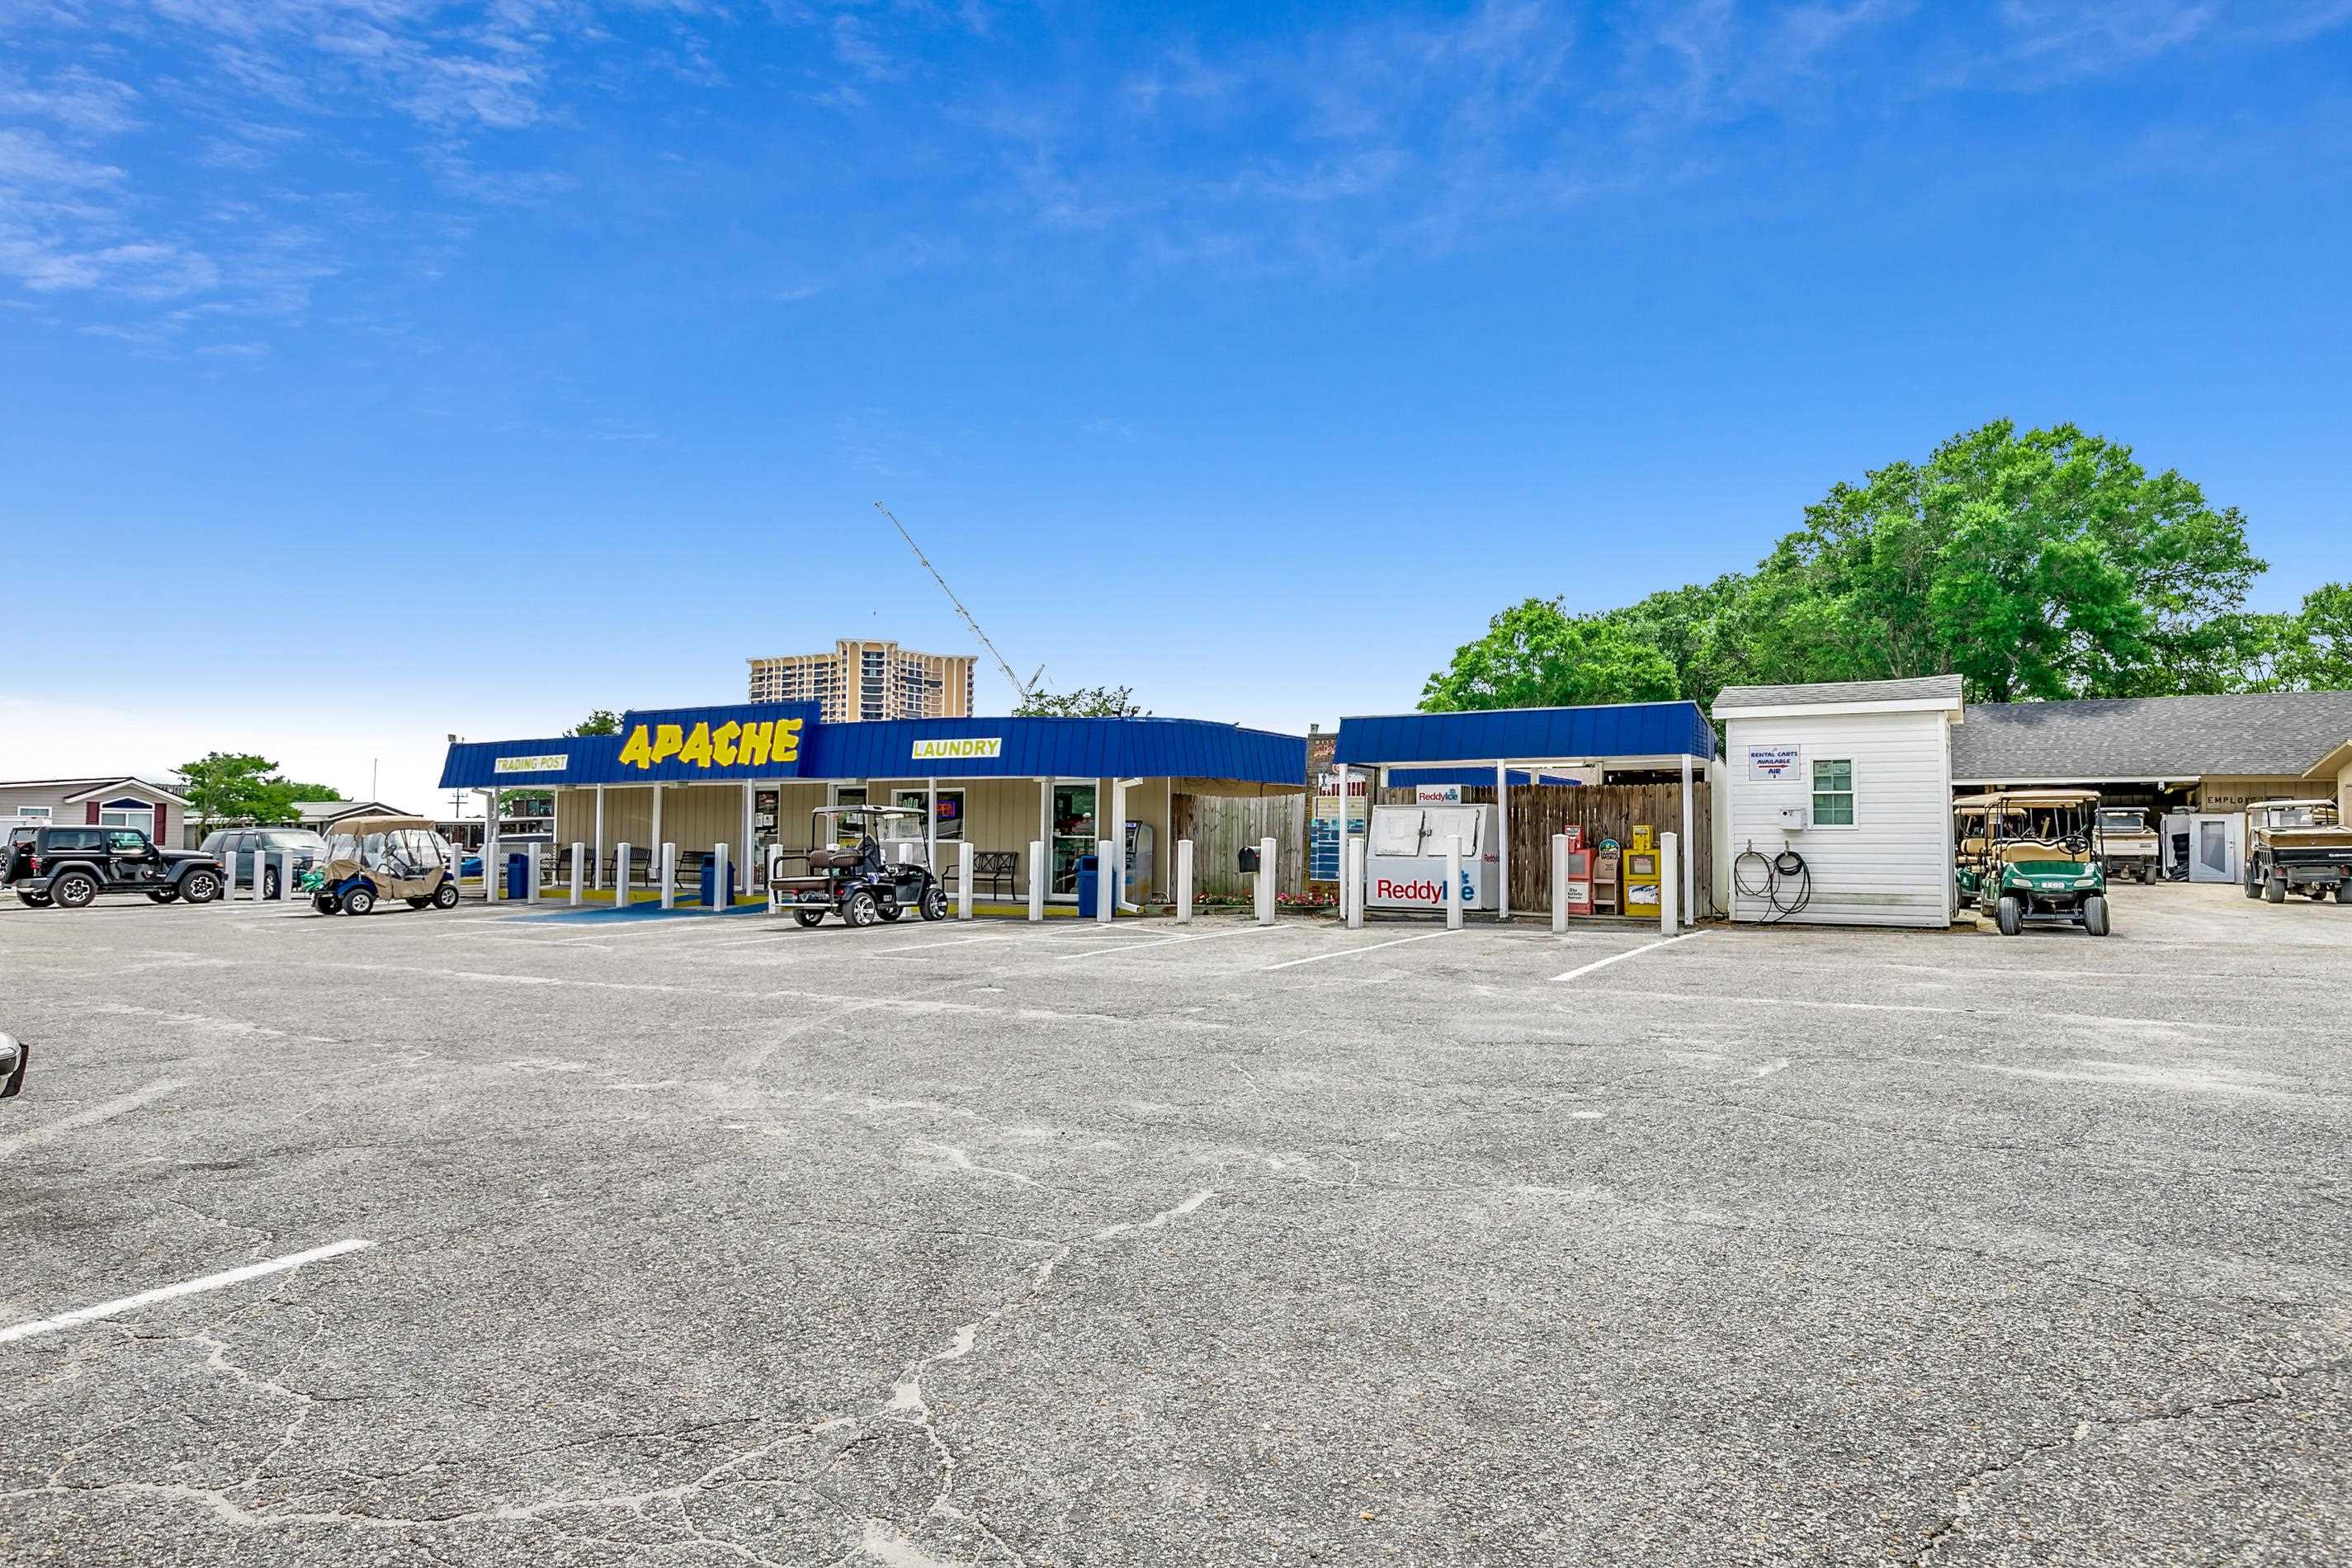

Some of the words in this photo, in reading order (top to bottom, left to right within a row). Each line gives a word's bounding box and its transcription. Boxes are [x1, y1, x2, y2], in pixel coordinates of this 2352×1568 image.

[619, 718, 803, 769] APACHE
[914, 739, 999, 757] LAUNDRY
[497, 758, 538, 771] TRADING
[541, 756, 566, 768] POST
[1377, 879, 1475, 904] ReddyIe
